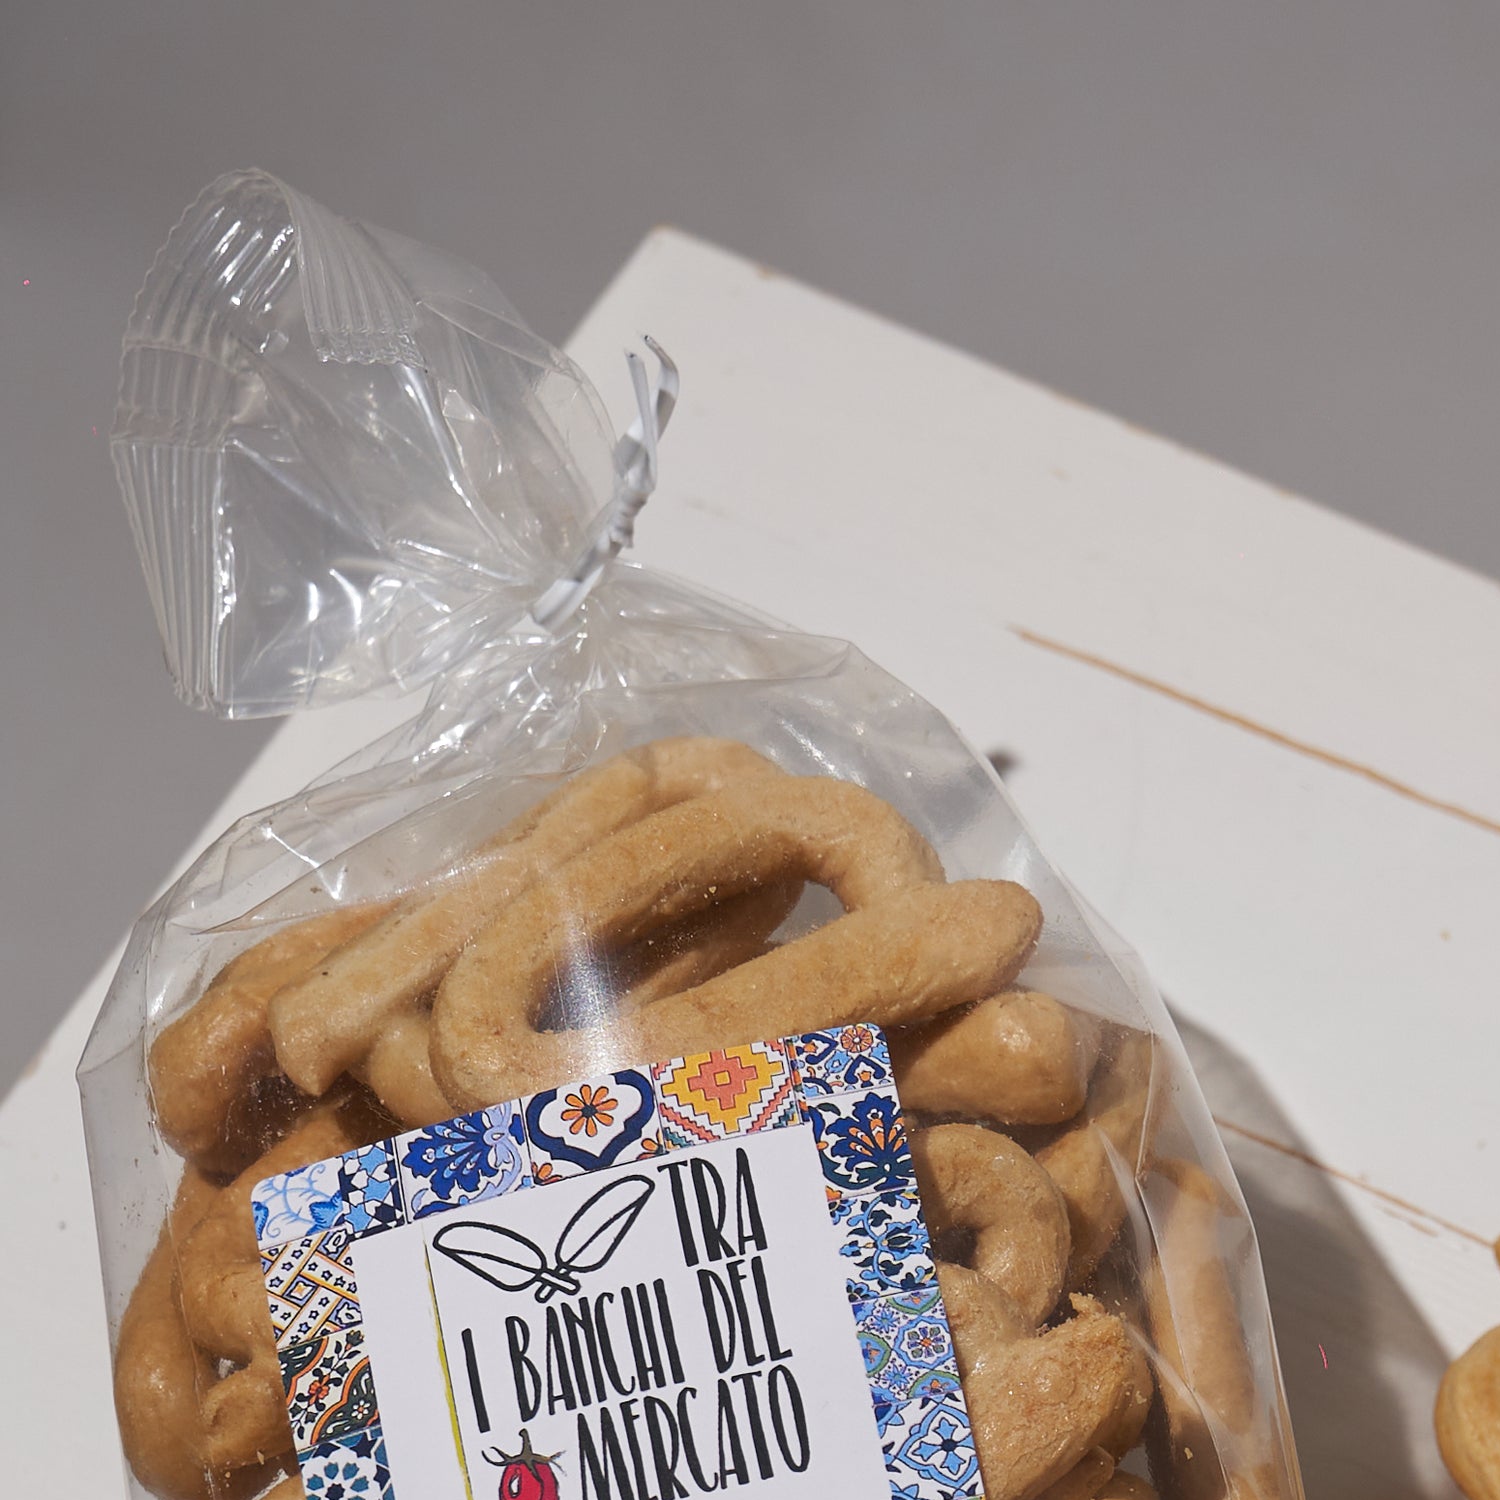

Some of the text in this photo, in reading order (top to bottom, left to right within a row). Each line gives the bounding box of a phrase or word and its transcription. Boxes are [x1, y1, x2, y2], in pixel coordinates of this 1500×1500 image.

[656, 1147, 768, 1268] TRA
[461, 1255, 793, 1434] I BANCHI DEL
